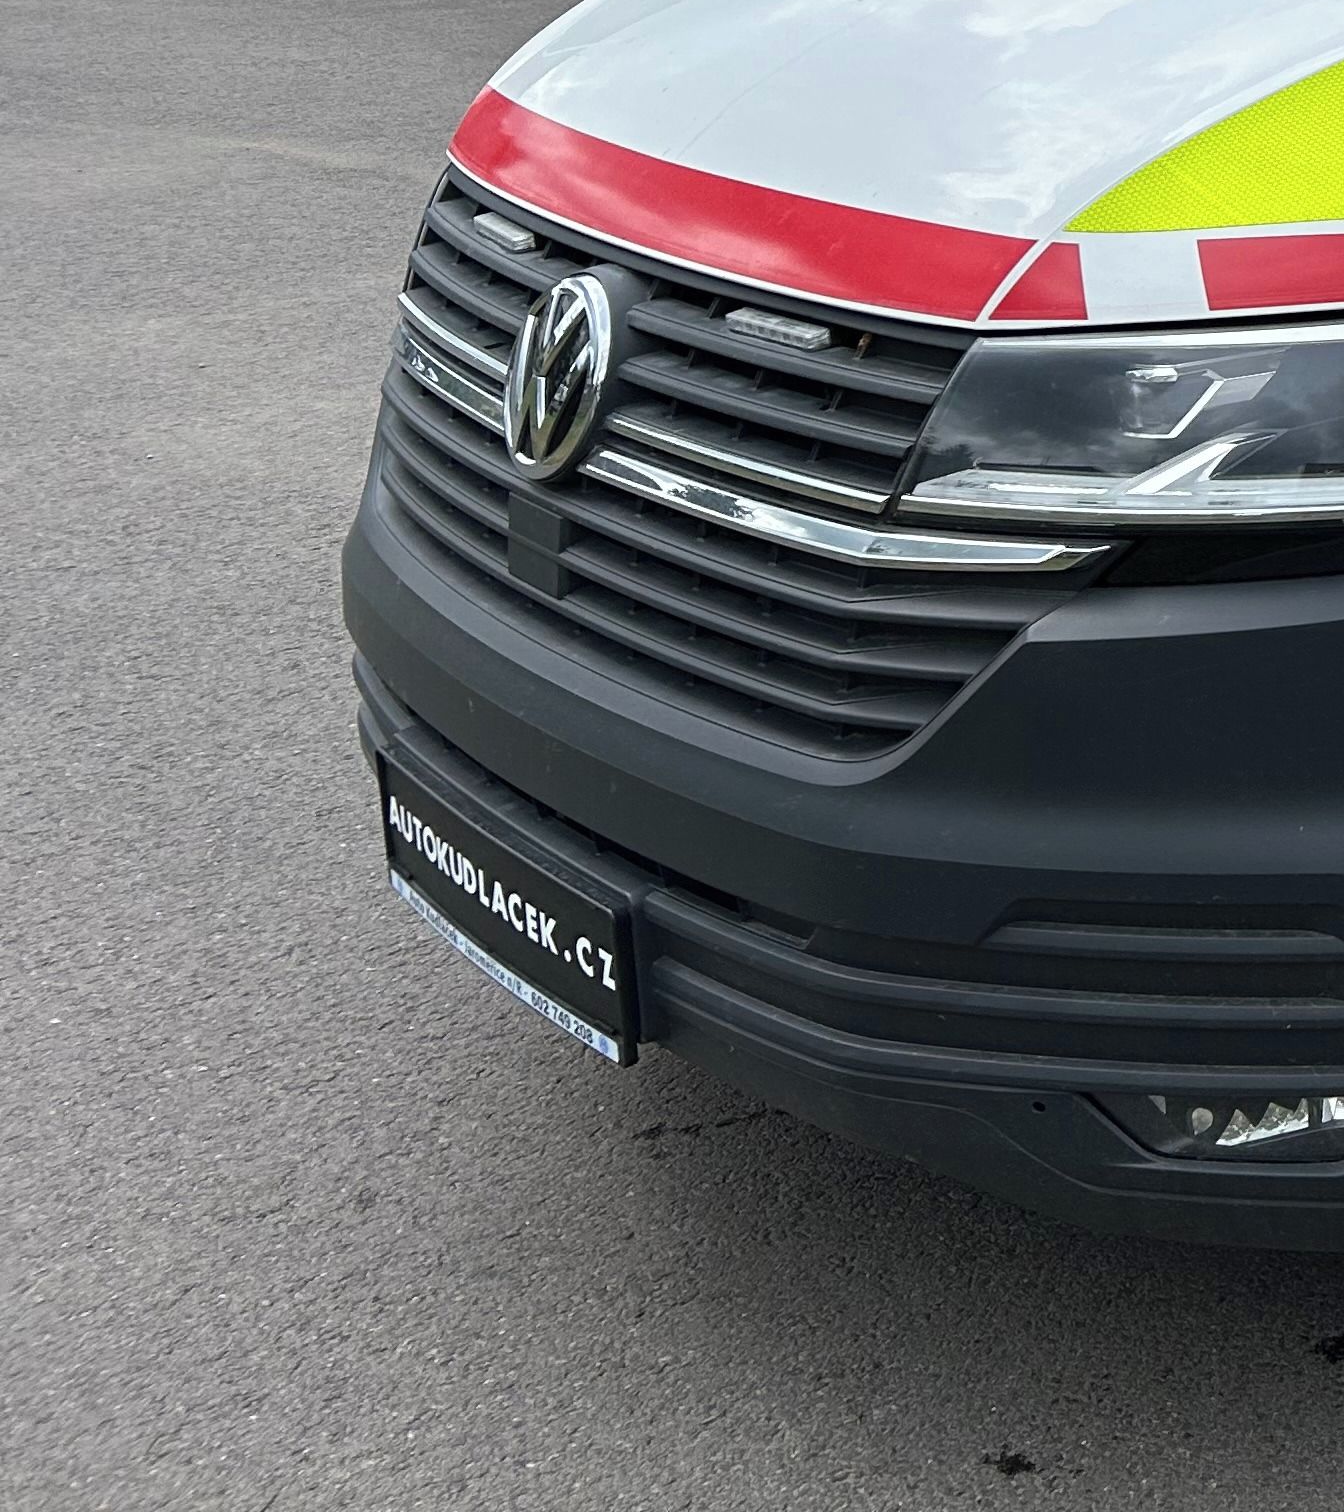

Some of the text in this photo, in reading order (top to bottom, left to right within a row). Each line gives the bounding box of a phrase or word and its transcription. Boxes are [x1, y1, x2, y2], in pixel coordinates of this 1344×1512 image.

[389, 795, 616, 991] AUTOKUDLACEK.CZ
[531, 991, 550, 1016] 602
[551, 1004, 571, 1029] 749
[573, 1019, 594, 1044] 208
